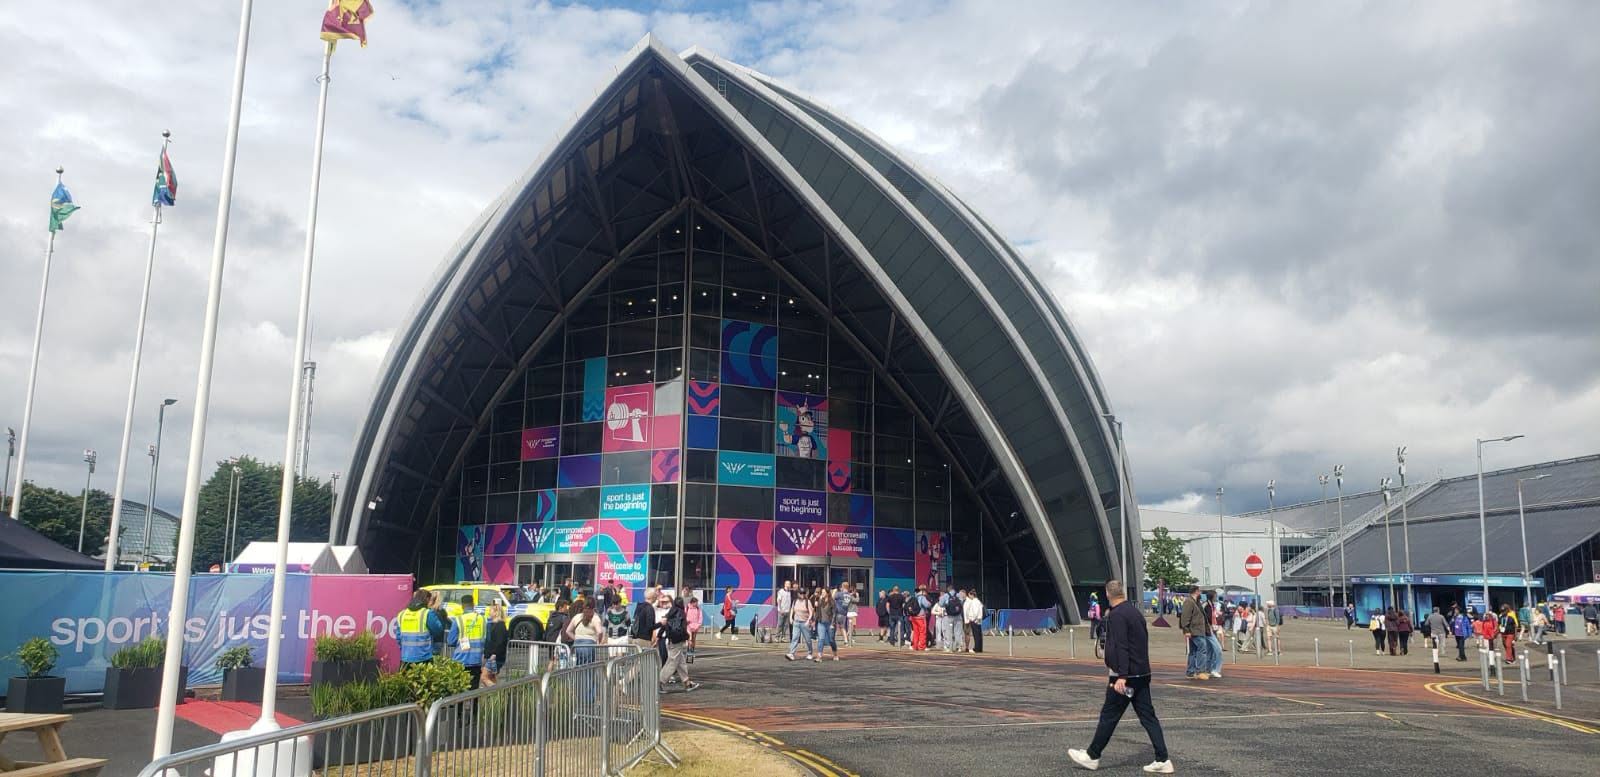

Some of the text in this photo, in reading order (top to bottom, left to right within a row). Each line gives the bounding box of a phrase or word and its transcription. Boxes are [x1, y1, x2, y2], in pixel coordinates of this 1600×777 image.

[606, 491, 645, 503] sport is just
[603, 500, 648, 512] the beginning
[782, 498, 819, 507] sport is just
[779, 504, 822, 515] the beginning
[827, 531, 869, 539] commonwealth
[603, 560, 642, 570] Welcome to
[600, 571, 645, 581] SEC Armadillo
[50, 611, 162, 653] sport
[298, 609, 357, 640] the
